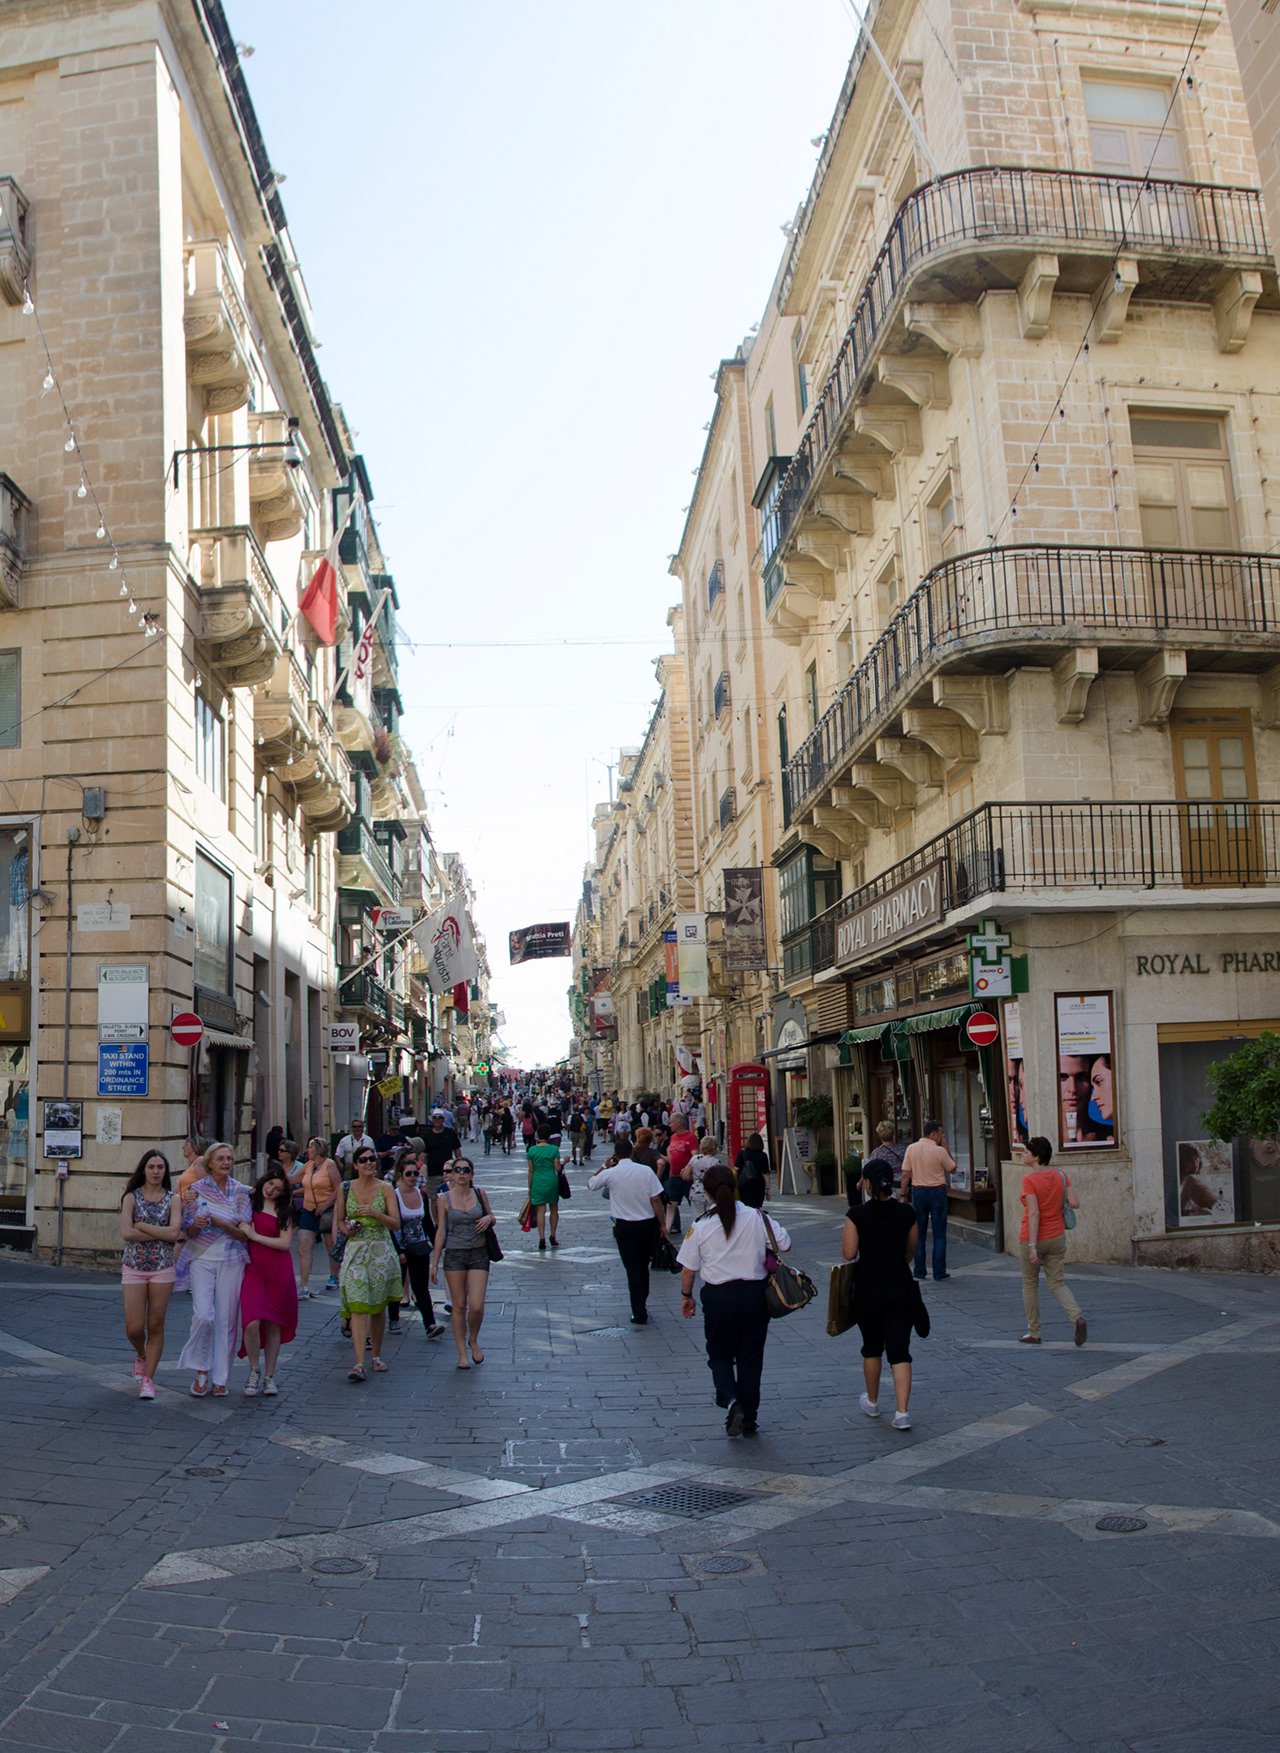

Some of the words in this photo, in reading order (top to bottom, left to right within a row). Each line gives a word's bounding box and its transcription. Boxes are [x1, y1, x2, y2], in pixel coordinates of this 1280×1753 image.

[837, 915, 868, 959] ROYAL
[871, 871, 939, 943] PHARMACY
[1136, 954, 1210, 975] ROYAL
[332, 1028, 355, 1038] BOV
